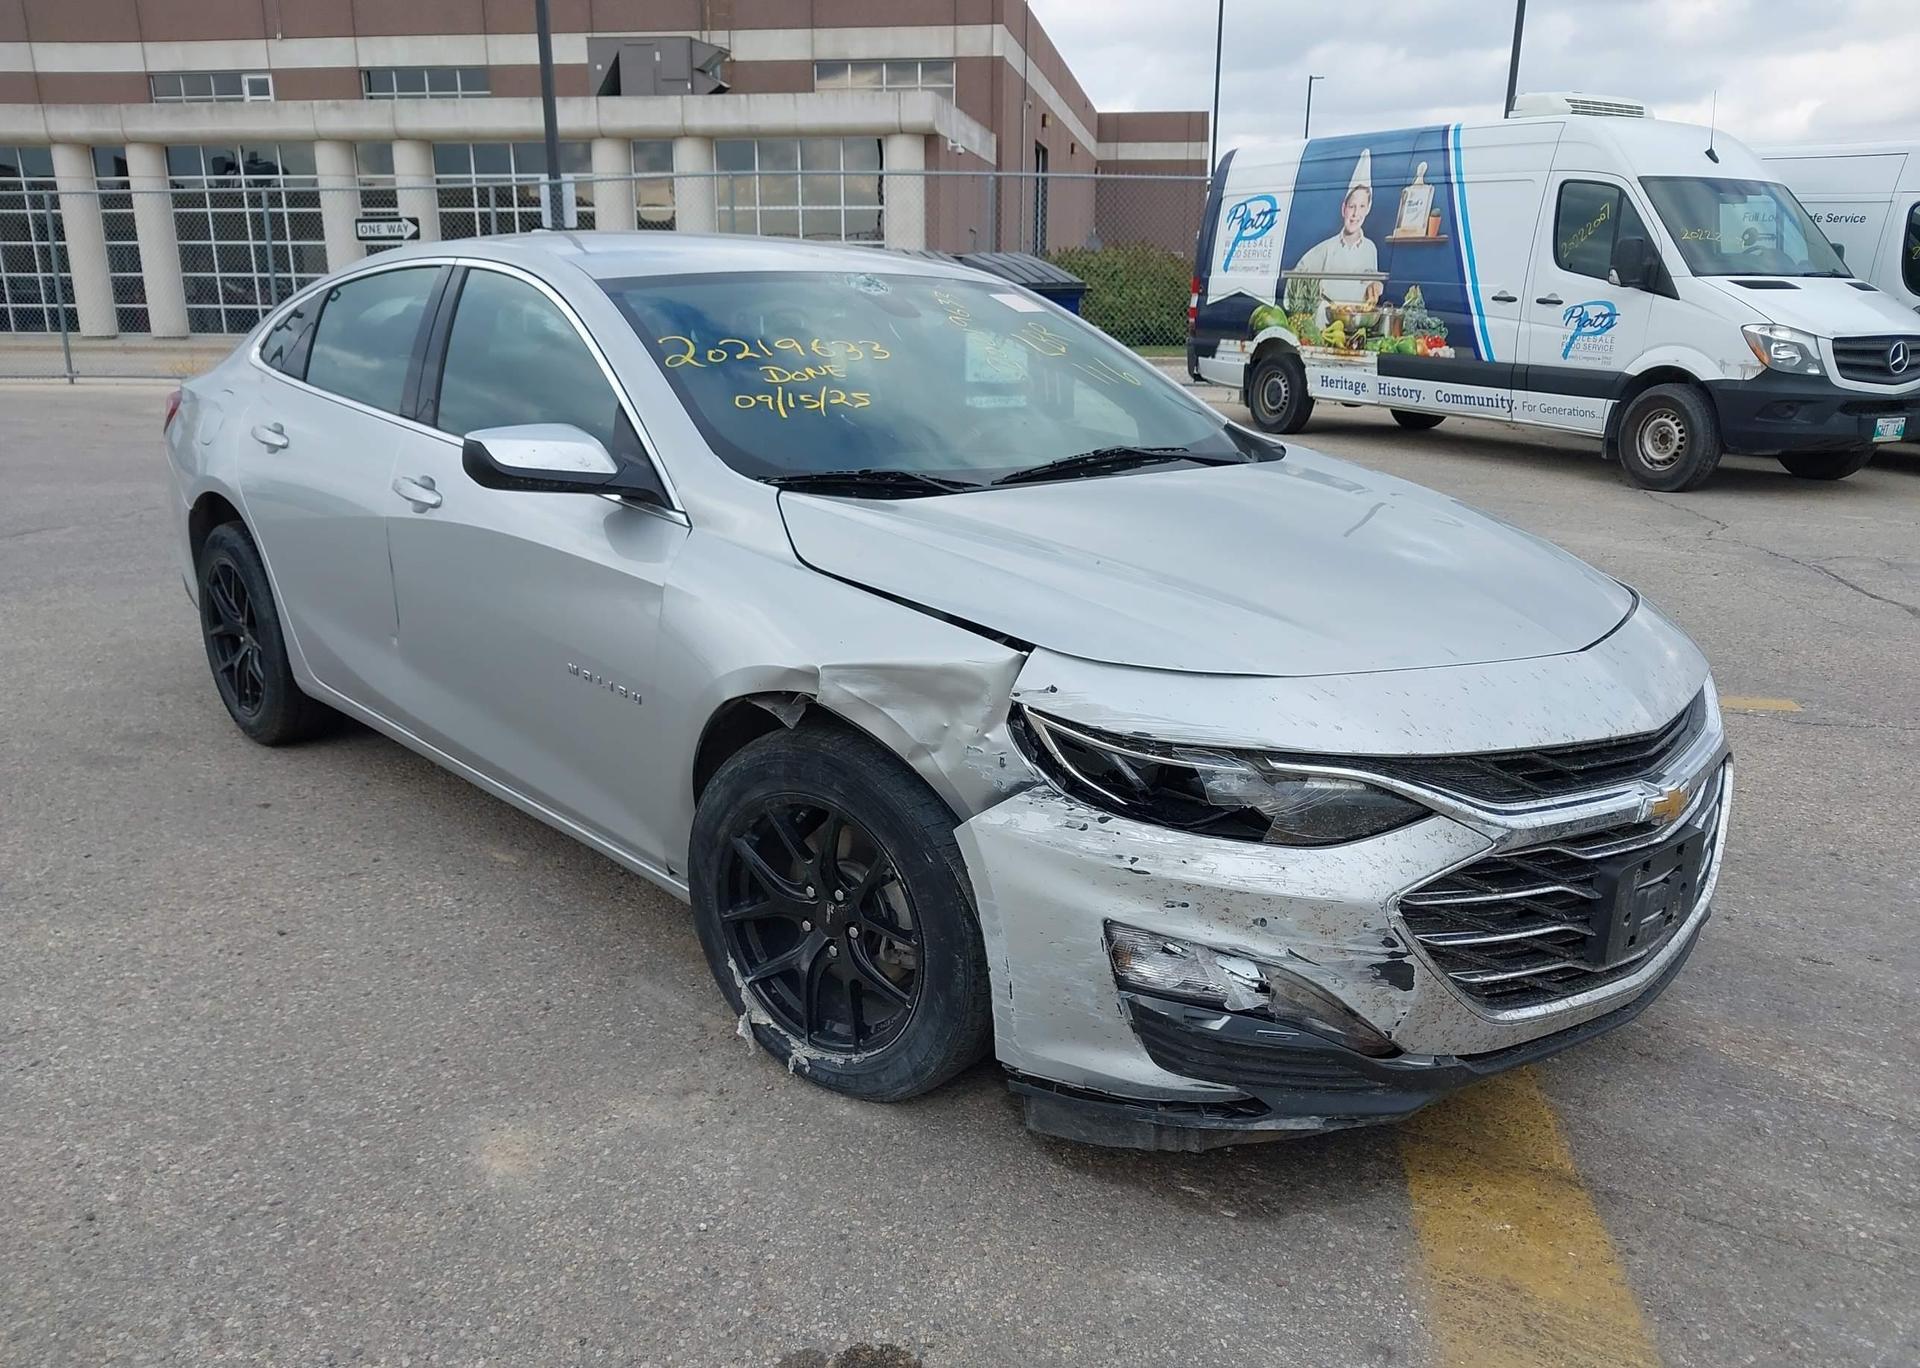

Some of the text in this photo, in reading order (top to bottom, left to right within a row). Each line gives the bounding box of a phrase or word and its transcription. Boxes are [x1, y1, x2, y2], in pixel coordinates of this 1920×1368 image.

[360, 223, 409, 234] ONE WAY
[1826, 213, 1867, 223] Service
[1562, 304, 1621, 330] Pratts
[657, 335, 891, 368] 20219633
[1582, 342, 1615, 352] SERVICE
[759, 364, 847, 384] DONE
[734, 385, 872, 418] 09/15/25
[1320, 375, 1604, 420] Heritage. History. Community. For Generations...
